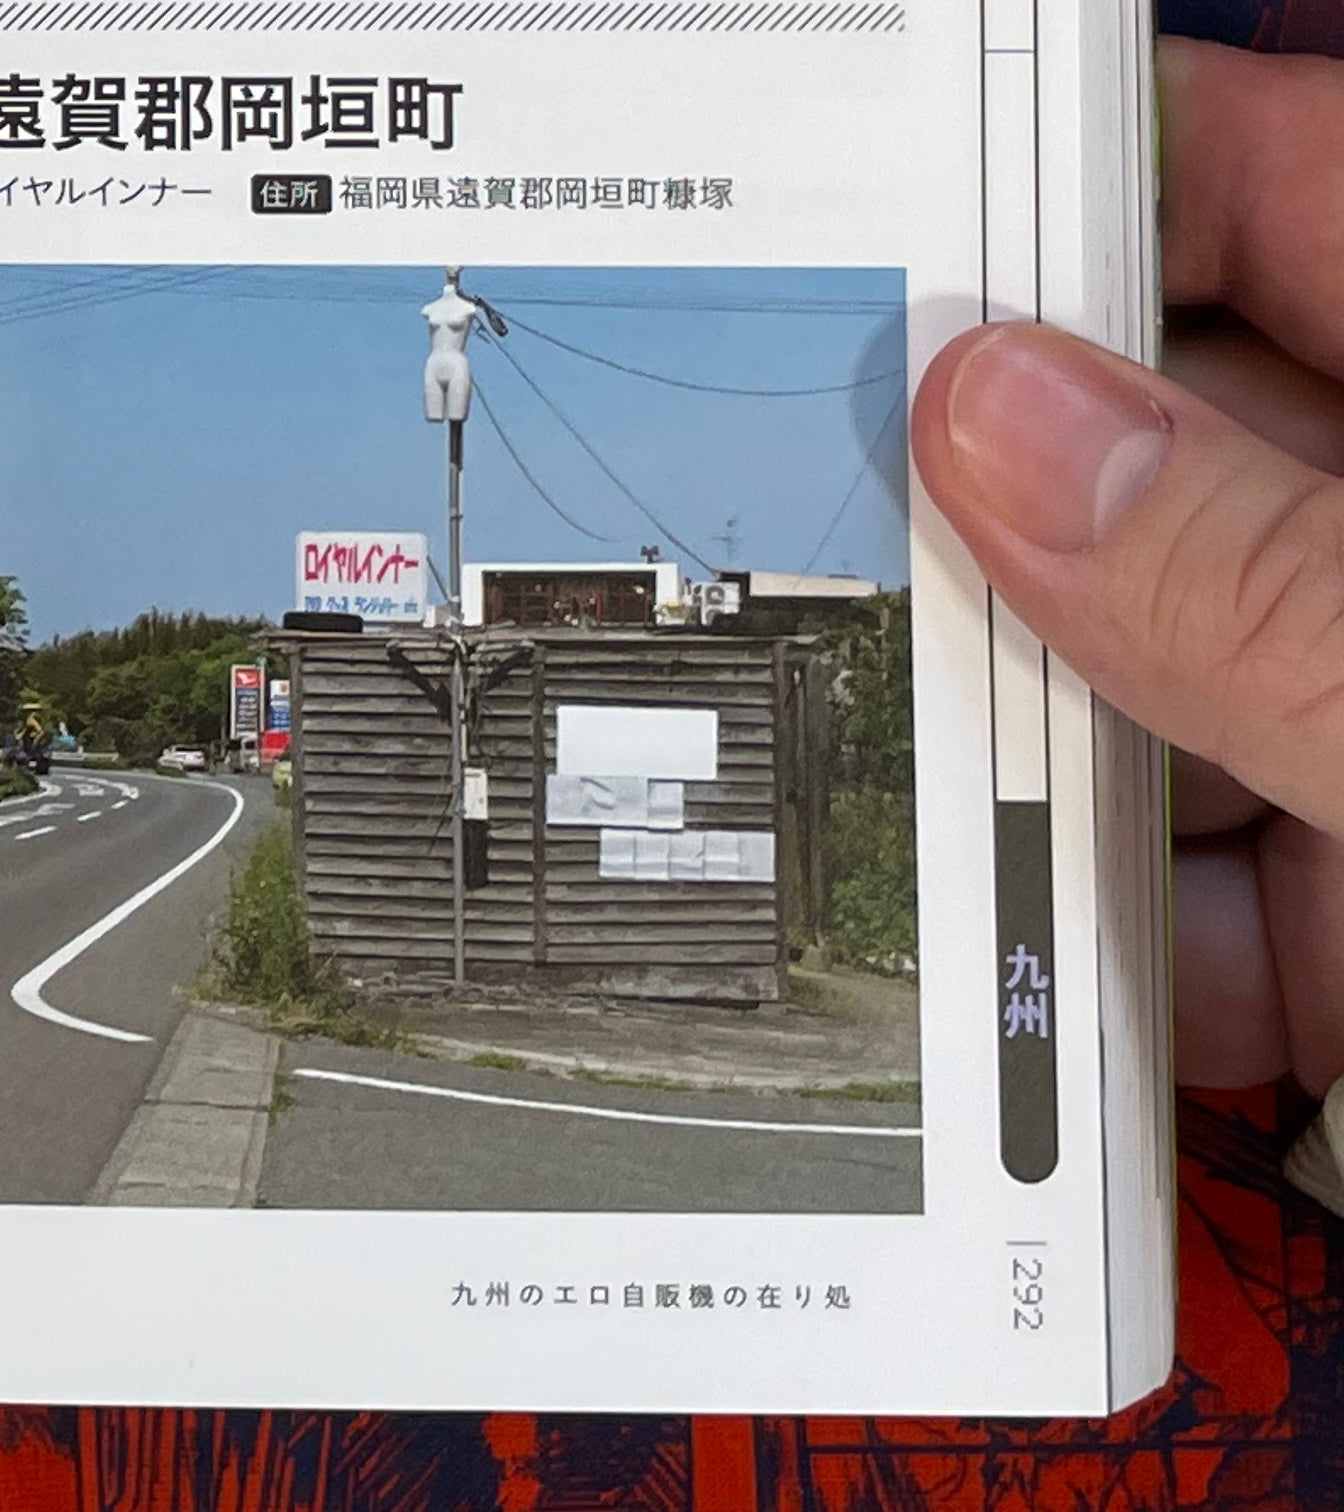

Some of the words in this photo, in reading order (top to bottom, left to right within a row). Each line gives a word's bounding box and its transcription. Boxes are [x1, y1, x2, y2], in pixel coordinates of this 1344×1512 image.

[259, 180, 320, 209] 住所
[339, 176, 734, 210] 福岡県遠賀郡岡垣町糠塚
[1004, 943, 1050, 1039] 九州
[451, 1281, 852, 1310] 九州のエロ自販機の在り処
[1011, 1256, 1044, 1331] 292
